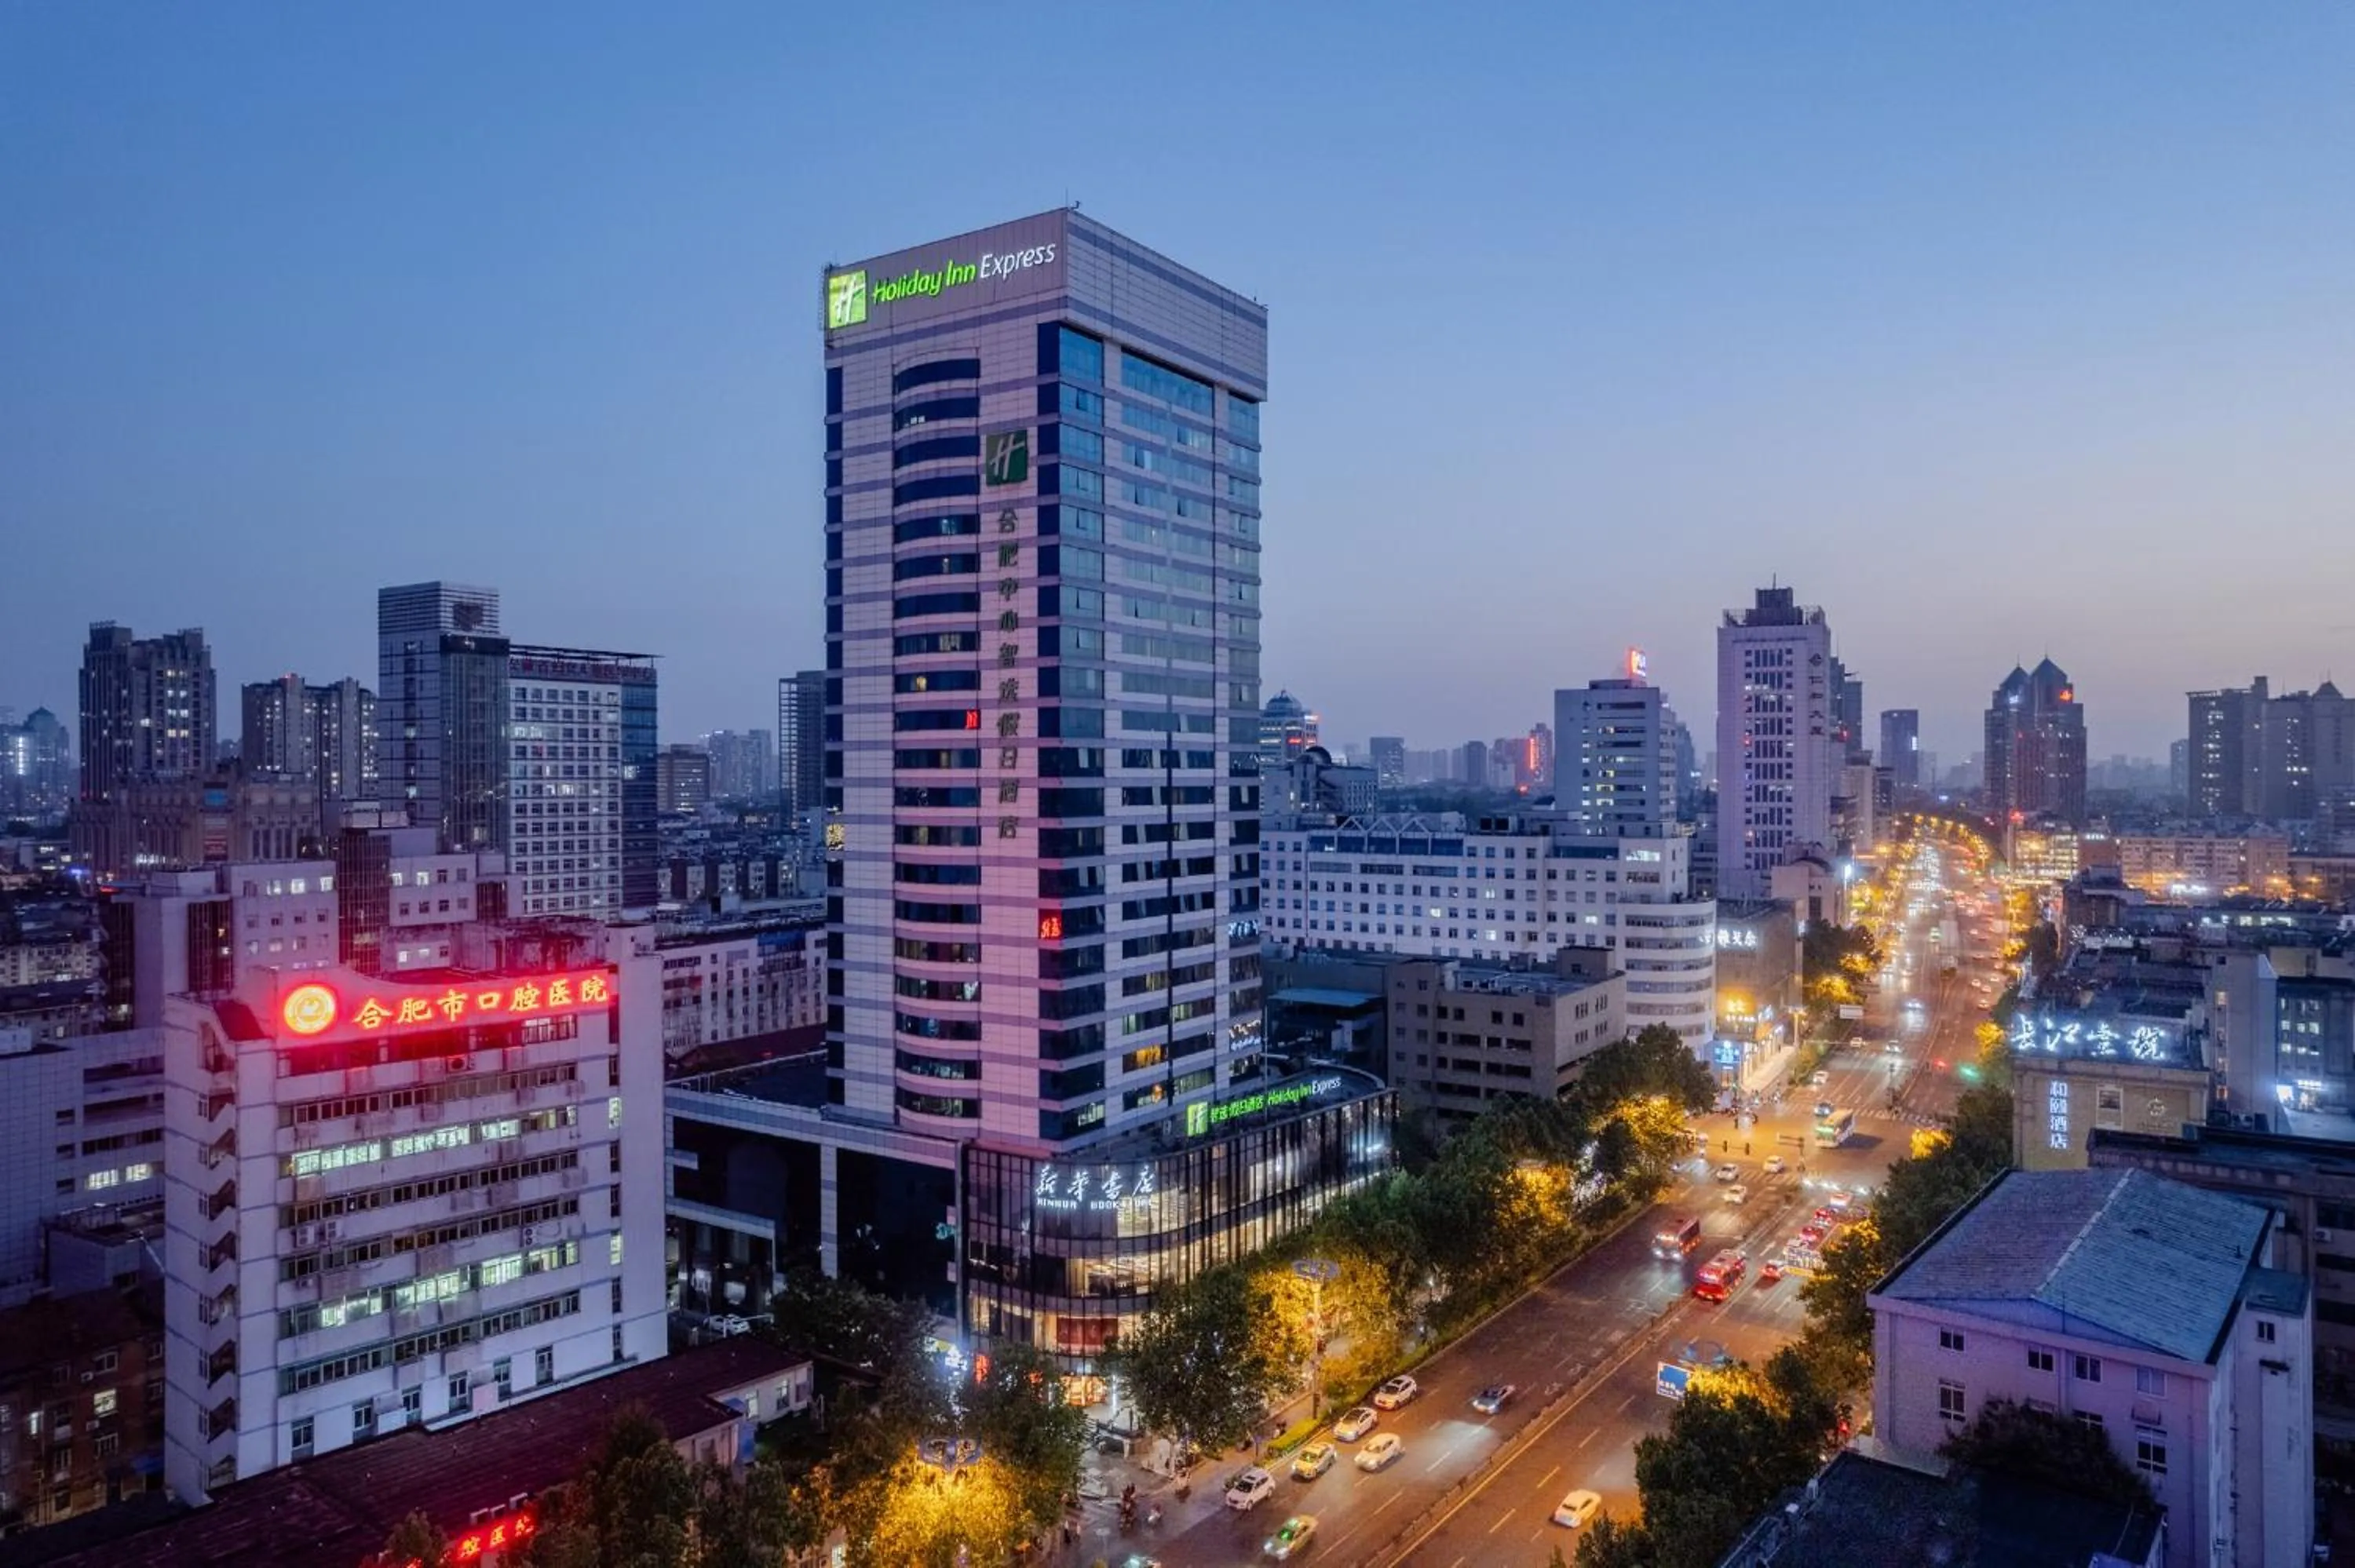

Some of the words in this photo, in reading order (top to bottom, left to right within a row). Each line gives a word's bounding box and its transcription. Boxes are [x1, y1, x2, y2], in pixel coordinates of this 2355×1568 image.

[873, 268, 942, 305] Holiday
[946, 258, 977, 287] Inn
[980, 242, 1057, 281] Express
[352, 975, 609, 1030] 合肥市口腔医院
[1312, 1076, 1342, 1095] Express
